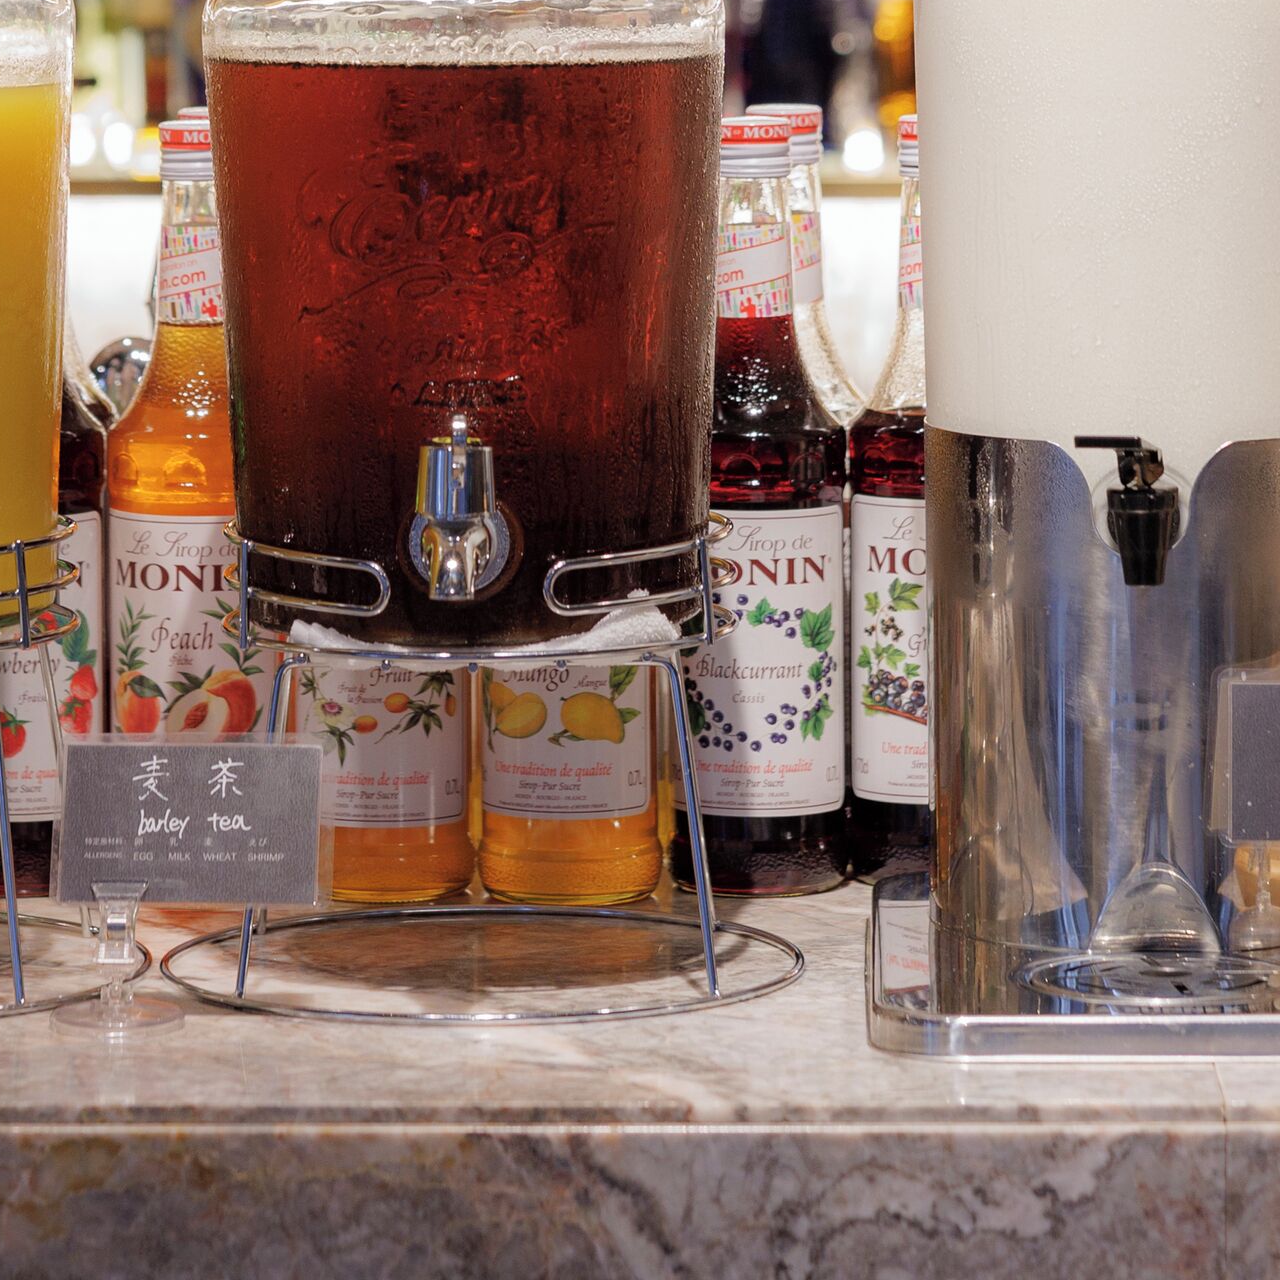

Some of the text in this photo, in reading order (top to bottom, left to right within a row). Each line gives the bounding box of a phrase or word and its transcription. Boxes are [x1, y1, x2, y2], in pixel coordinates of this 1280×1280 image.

[728, 525, 787, 557] Sirop
[792, 534, 813, 549] de
[883, 516, 914, 541] Le
[126, 530, 238, 563] Le Sirop de
[116, 558, 237, 593] MONI
[710, 554, 826, 586] ONIN
[150, 617, 214, 653] Peach
[369, 666, 414, 687] Fruit
[696, 653, 803, 680] Blackcurrant
[574, 675, 608, 690] Mangue
[732, 690, 765, 704] Cassis
[208, 757, 244, 799] 茶
[378, 771, 388, 786] de
[512, 762, 557, 777] tradition
[560, 762, 572, 777] de
[575, 761, 614, 781] qualité
[764, 760, 775, 773] de
[138, 808, 251, 839] barley tea
[133, 852, 153, 861] EGG
[169, 852, 191, 861] MILK
[203, 852, 238, 862] WHEAT
[247, 852, 285, 862] SHRIMP
